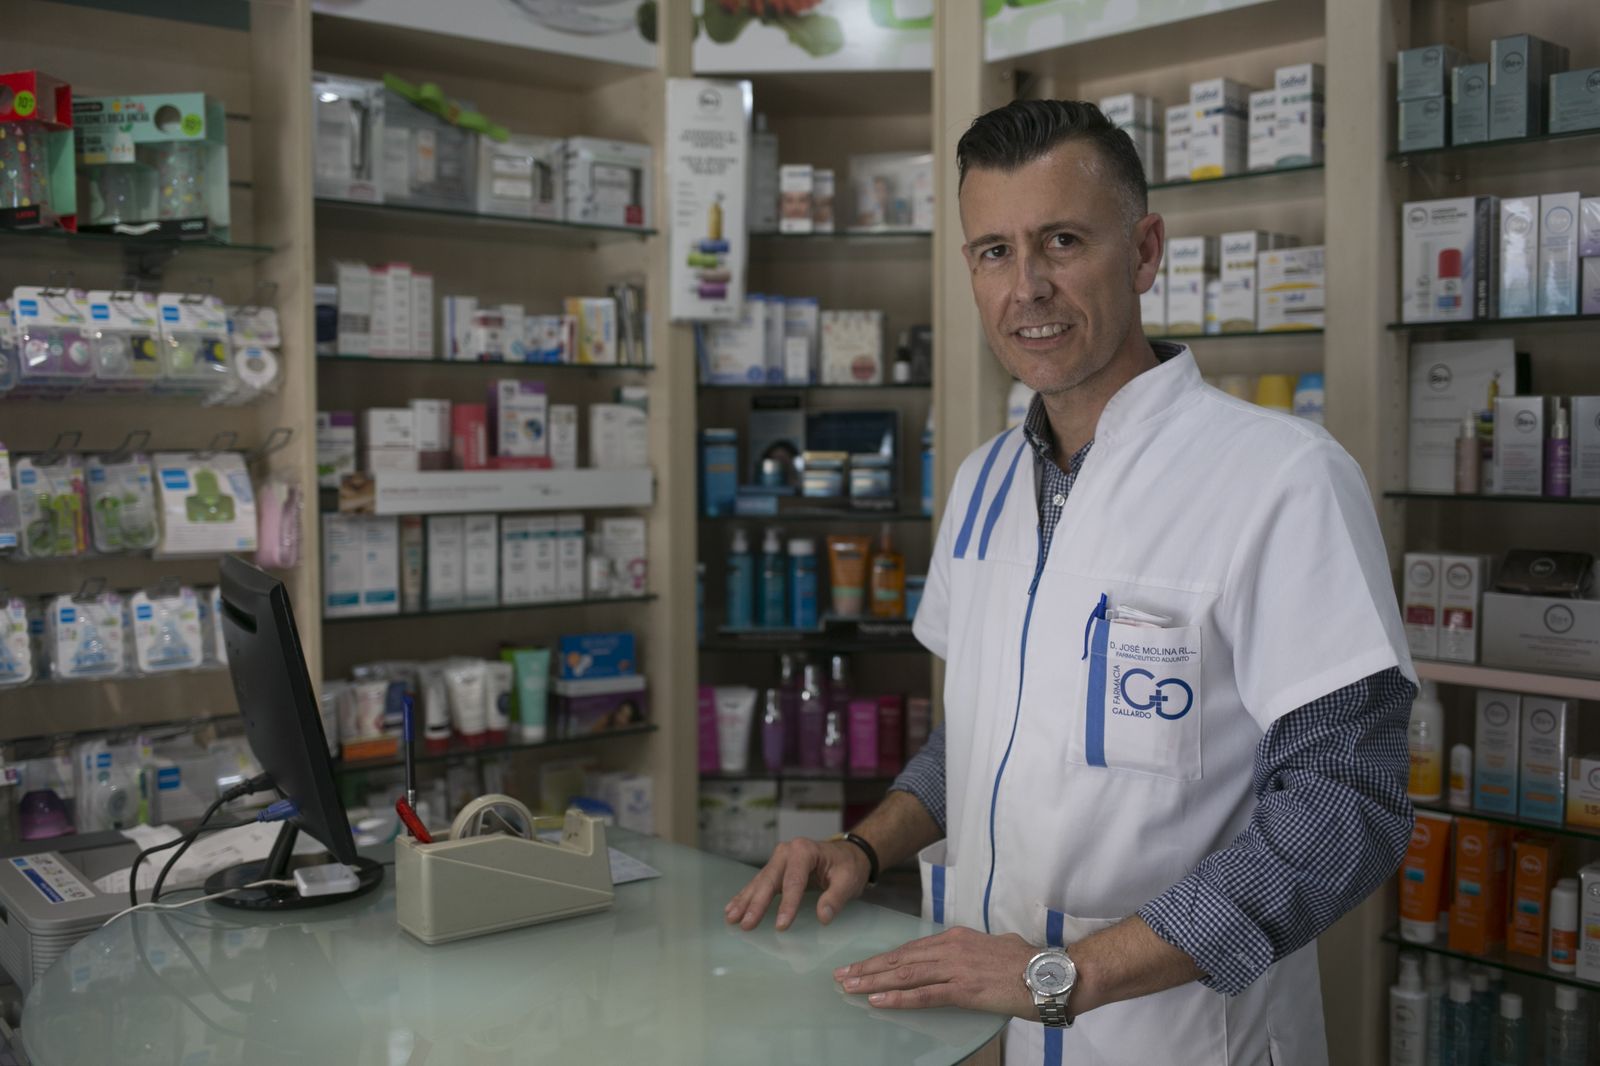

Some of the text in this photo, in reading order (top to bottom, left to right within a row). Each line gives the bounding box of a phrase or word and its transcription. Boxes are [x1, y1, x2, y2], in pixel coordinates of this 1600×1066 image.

[1119, 643, 1140, 653] JOSÉ
[1143, 647, 1177, 655] MOLINA
[1161, 655, 1190, 663] ADJUNTO
[1112, 708, 1152, 719] GALLARDO
